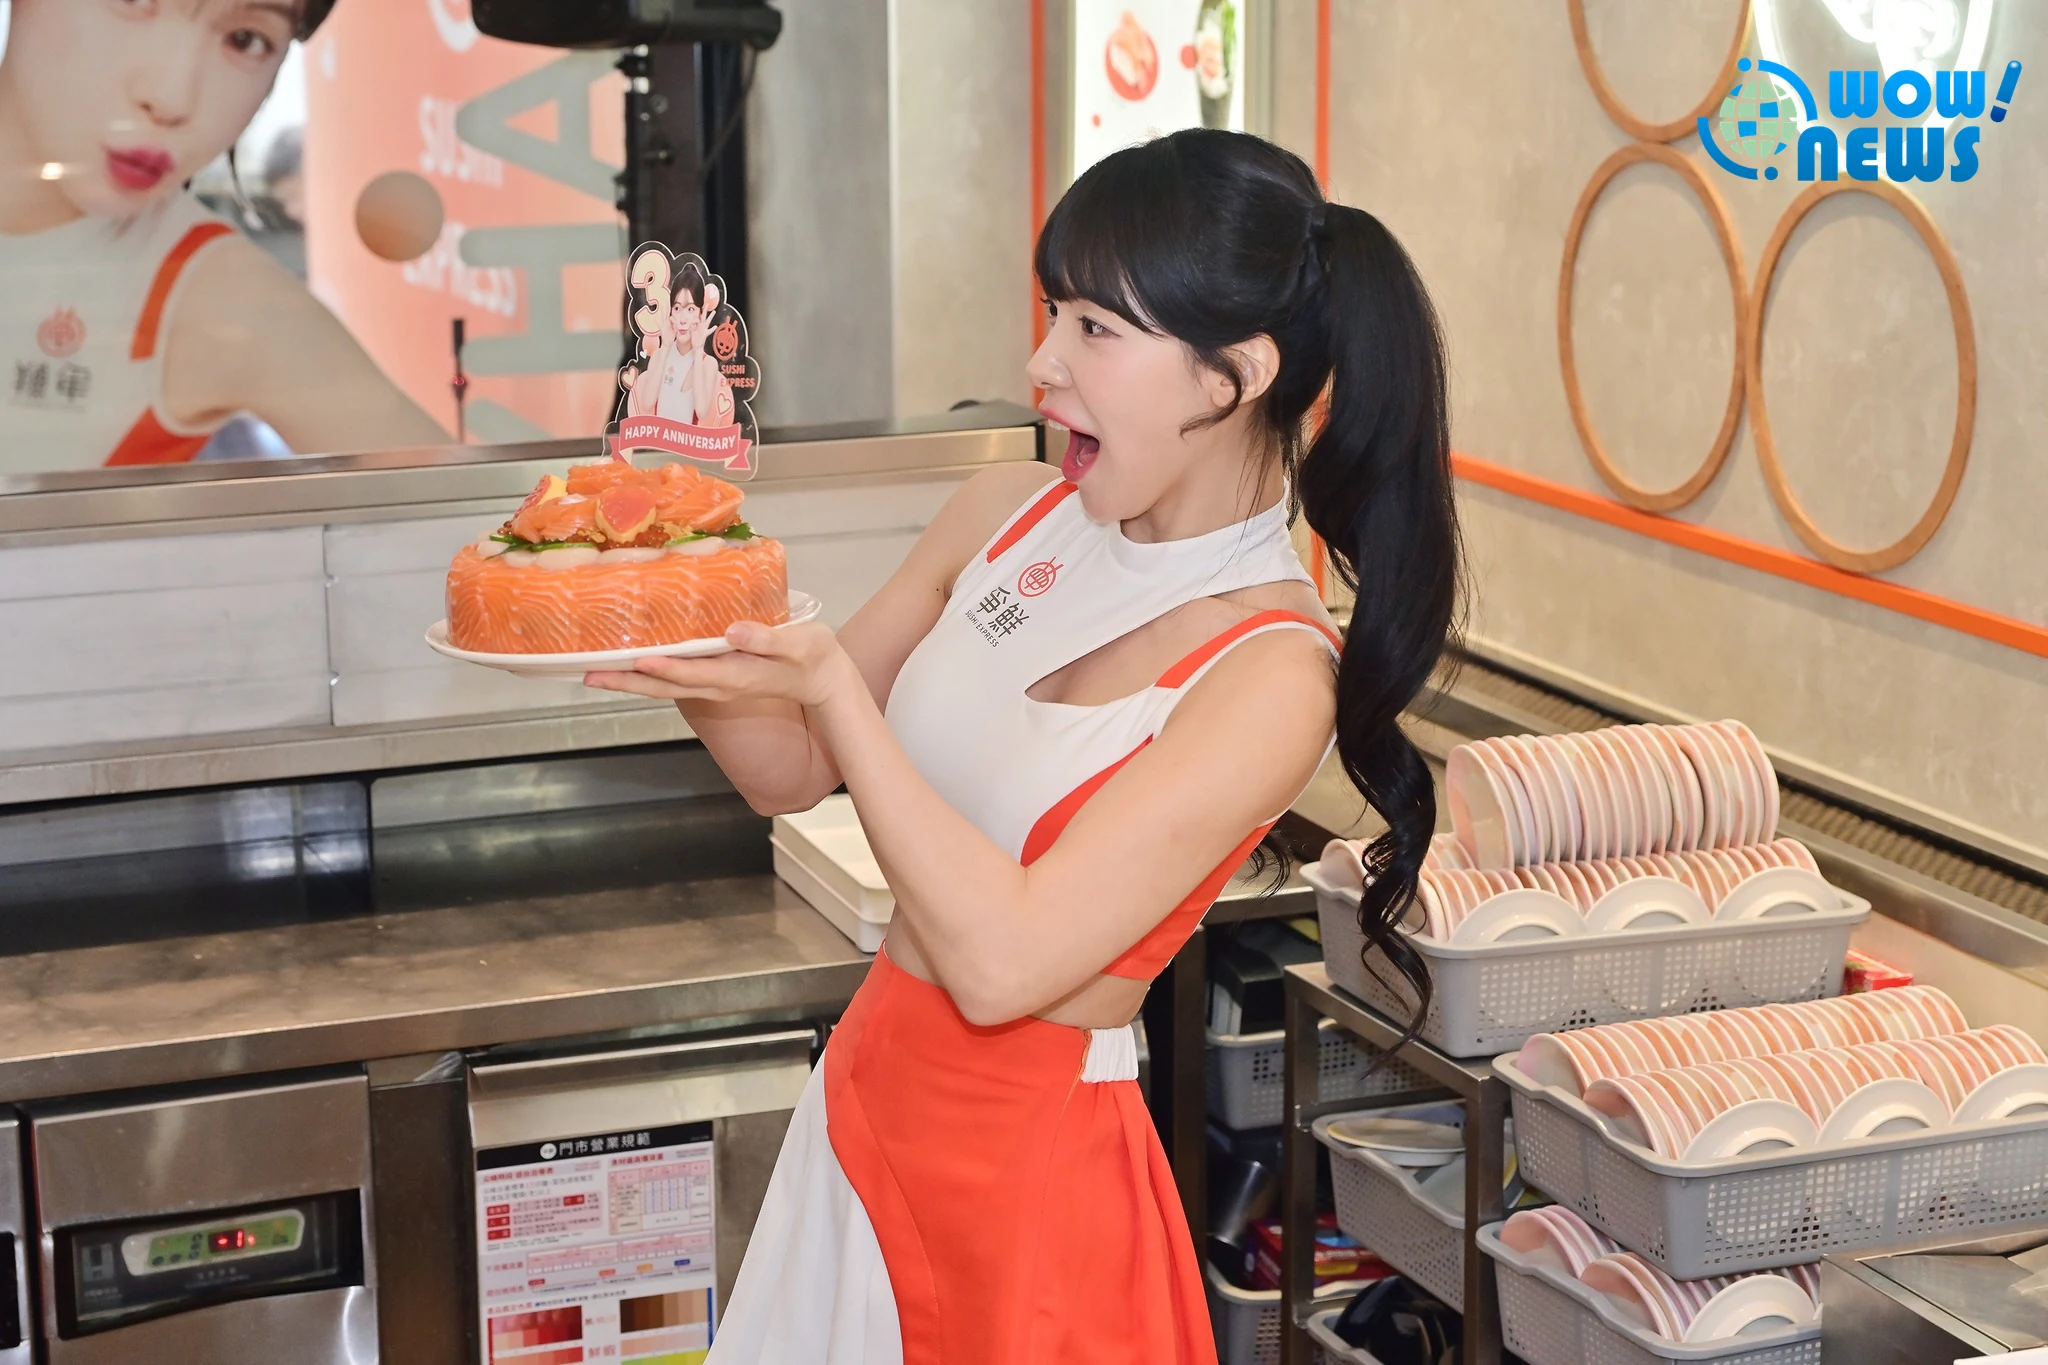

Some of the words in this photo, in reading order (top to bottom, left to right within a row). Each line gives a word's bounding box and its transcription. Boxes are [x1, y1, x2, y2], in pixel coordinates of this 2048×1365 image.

[631, 249, 672, 337] 3
[720, 377, 756, 389] EXPRESS
[625, 425, 660, 440] HAPPY
[662, 428, 736, 450] ANNIVERSARY
[975, 622, 1000, 648] EXPRESS
[559, 1132, 651, 1157] 門市營業規範
